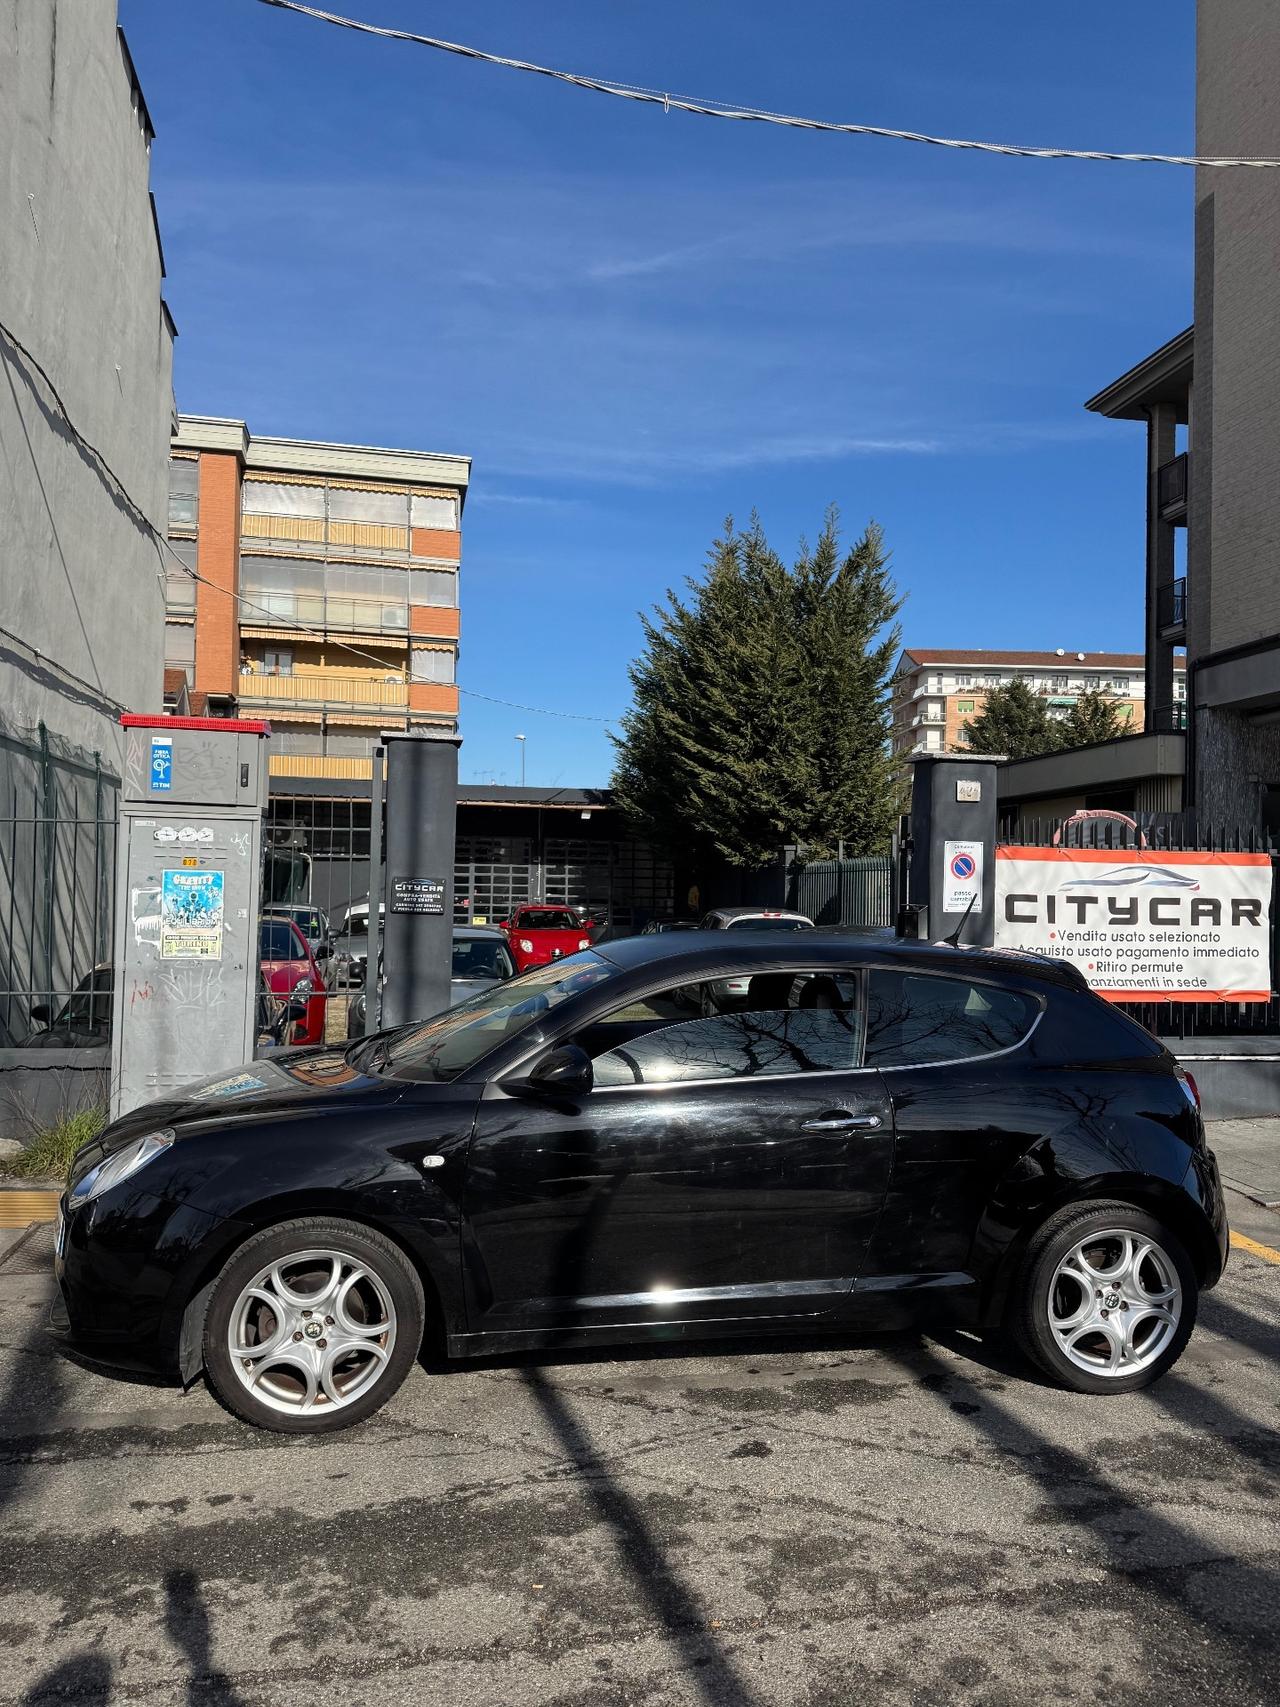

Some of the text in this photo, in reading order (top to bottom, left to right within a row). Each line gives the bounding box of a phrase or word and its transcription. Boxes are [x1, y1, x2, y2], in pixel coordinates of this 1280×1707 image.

[395, 884, 444, 892] CITYCAR
[1005, 894, 1262, 926] CITYCAR
[1057, 929, 1221, 943] Vendita usato selezionato
[1077, 946, 1113, 958] usato
[1116, 946, 1189, 960] pagamento
[1193, 946, 1260, 958] immediato
[1096, 961, 1184, 975] Ritiro permute
[1162, 976, 1174, 988] in
[1177, 976, 1208, 988] sede
